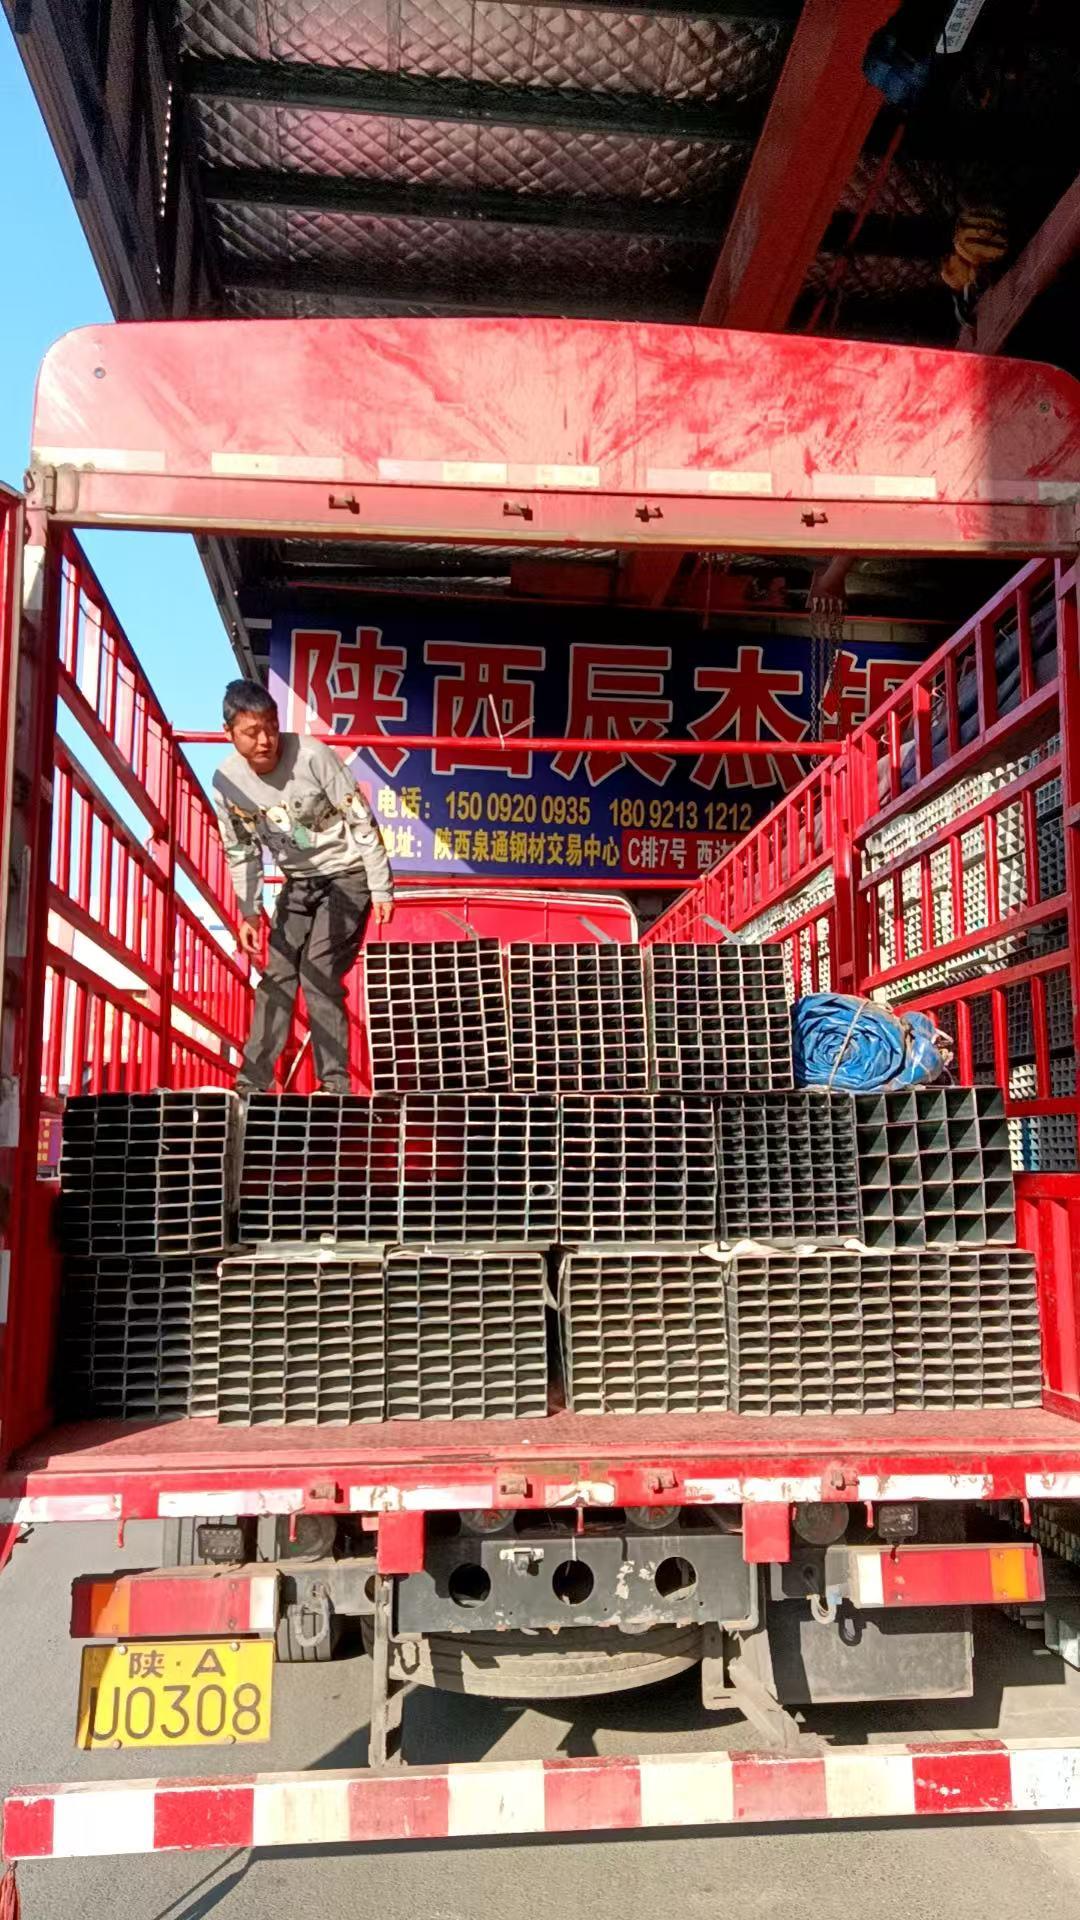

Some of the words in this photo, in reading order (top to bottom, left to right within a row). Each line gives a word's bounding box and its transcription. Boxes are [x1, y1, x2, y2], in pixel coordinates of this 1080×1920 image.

[446, 791, 482, 820] 150
[487, 794, 536, 823] 0920
[541, 796, 591, 825] 0935
[609, 799, 644, 827] 180
[650, 800, 697, 829] 9213
[704, 802, 752, 831] 1212
[433, 828, 619, 867] 陕西泉通钢材交易中心
[628, 836, 687, 869] C排7号
[88, 1683, 261, 1741] U0308
